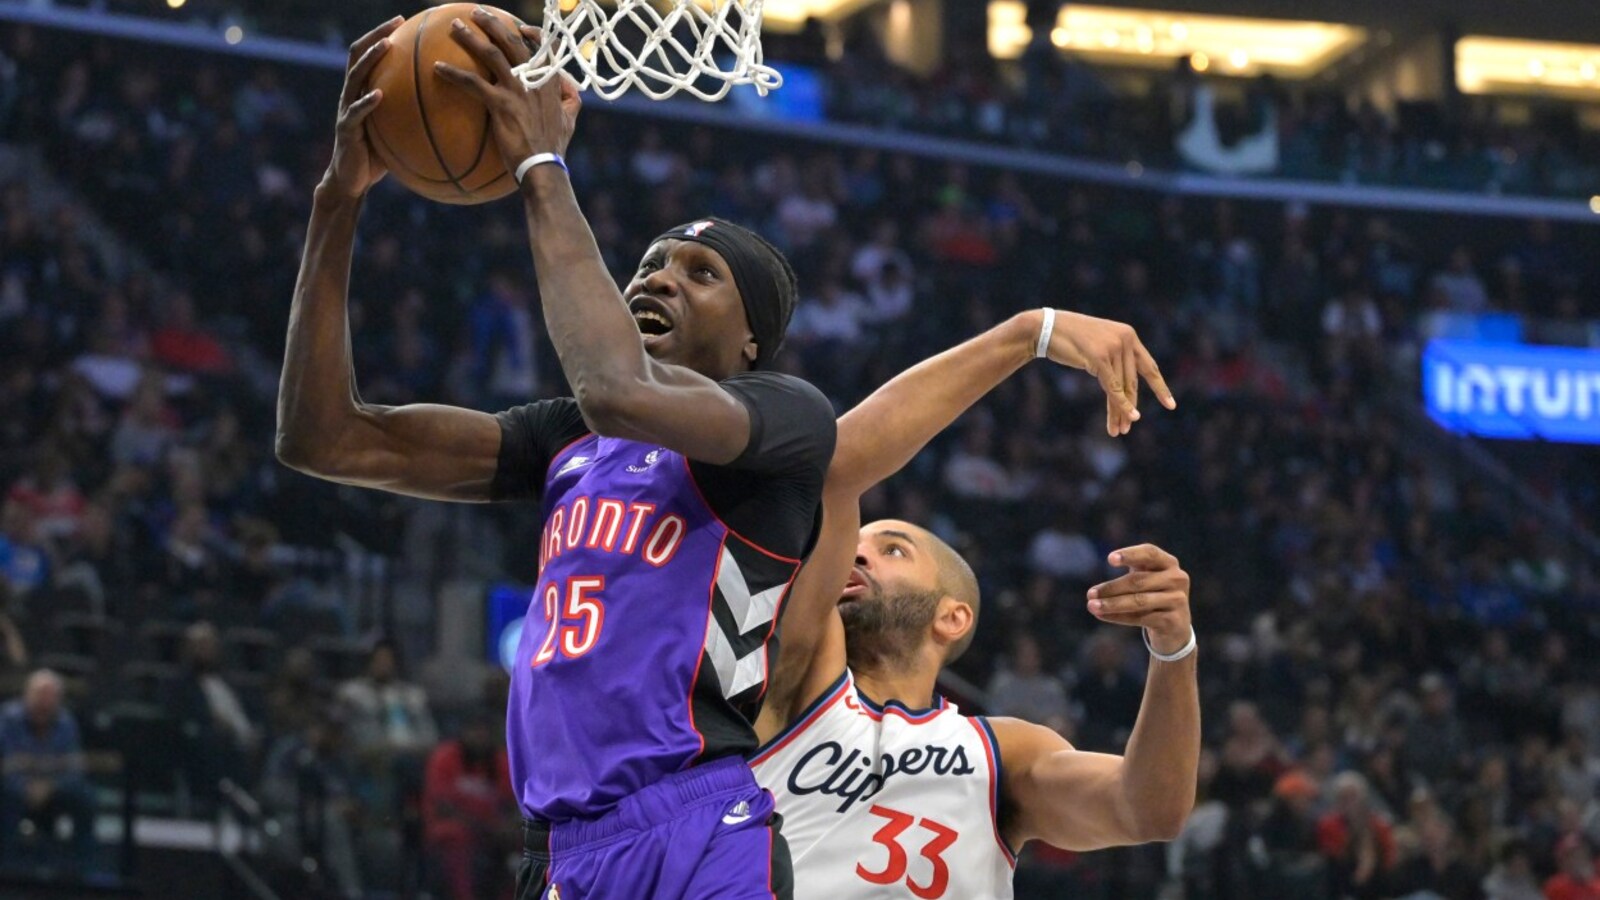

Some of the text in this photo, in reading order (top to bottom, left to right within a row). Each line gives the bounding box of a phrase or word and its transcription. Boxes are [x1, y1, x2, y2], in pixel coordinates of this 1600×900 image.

[1436, 363, 1600, 420] INTUI
[538, 496, 687, 574] ORONTO
[531, 575, 605, 668] 25
[855, 804, 959, 900] 33
